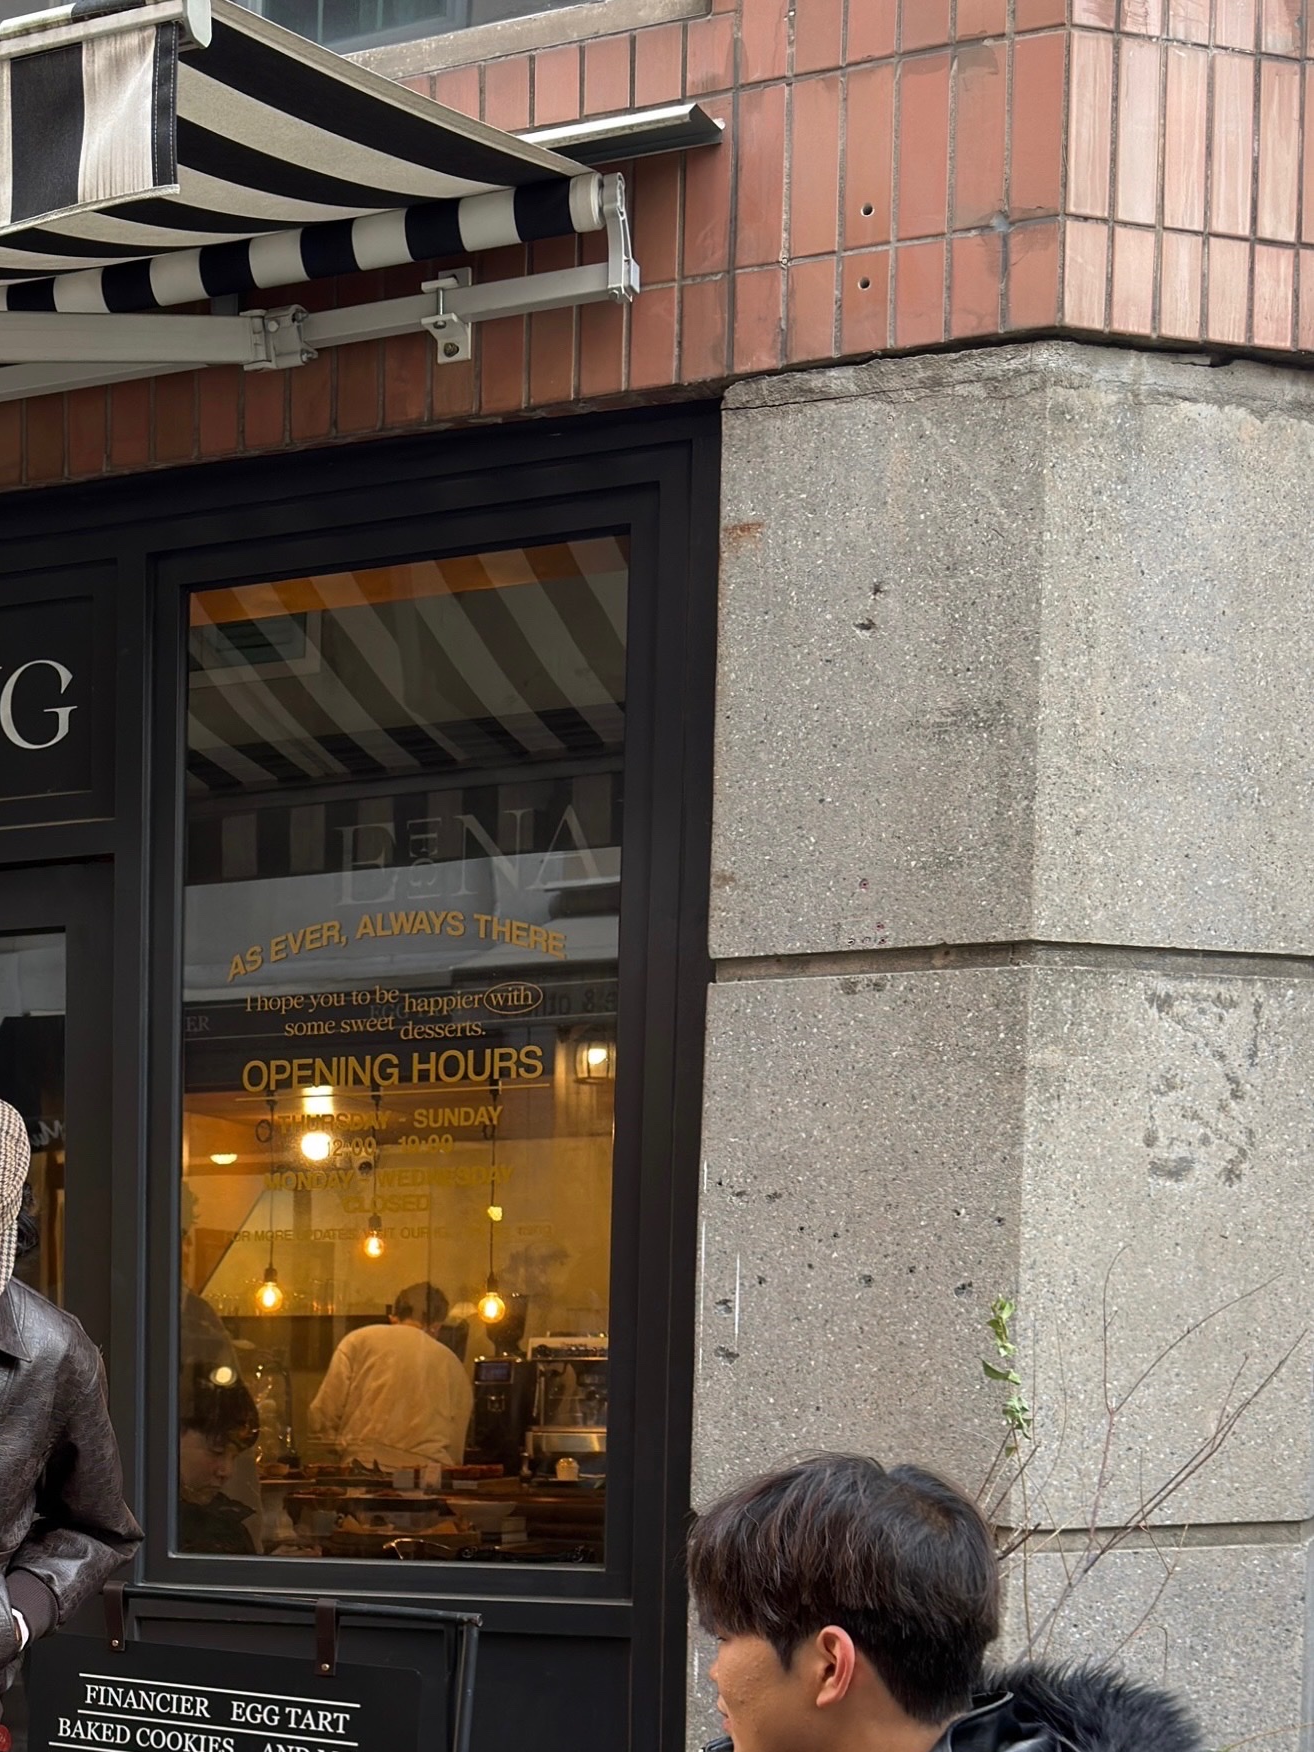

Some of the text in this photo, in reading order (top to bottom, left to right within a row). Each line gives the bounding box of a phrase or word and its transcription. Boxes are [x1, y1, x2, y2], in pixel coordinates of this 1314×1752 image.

[227, 911, 566, 983] AS EVER, ALWAYS THERE
[246, 995, 253, 1012] I
[255, 990, 304, 1015] hope
[308, 988, 346, 1012] you
[352, 984, 371, 1006] to
[375, 985, 399, 1004] be
[404, 991, 483, 1017] happier
[489, 987, 533, 1007] with
[285, 1017, 336, 1037] some
[340, 1014, 395, 1034] sweet
[400, 1019, 486, 1041] desserts.
[243, 1045, 543, 1093] OPENING HOURS
[278, 1111, 390, 1134] THURSDAY
[413, 1105, 503, 1129] SUNDAY
[259, 1170, 353, 1191] MONDAY
[342, 1193, 430, 1214] CLOSED
[254, 1228, 294, 1242] MORE
[85, 1684, 350, 1734] FINANCIER EGG TART
[58, 1718, 131, 1744] BAKED
